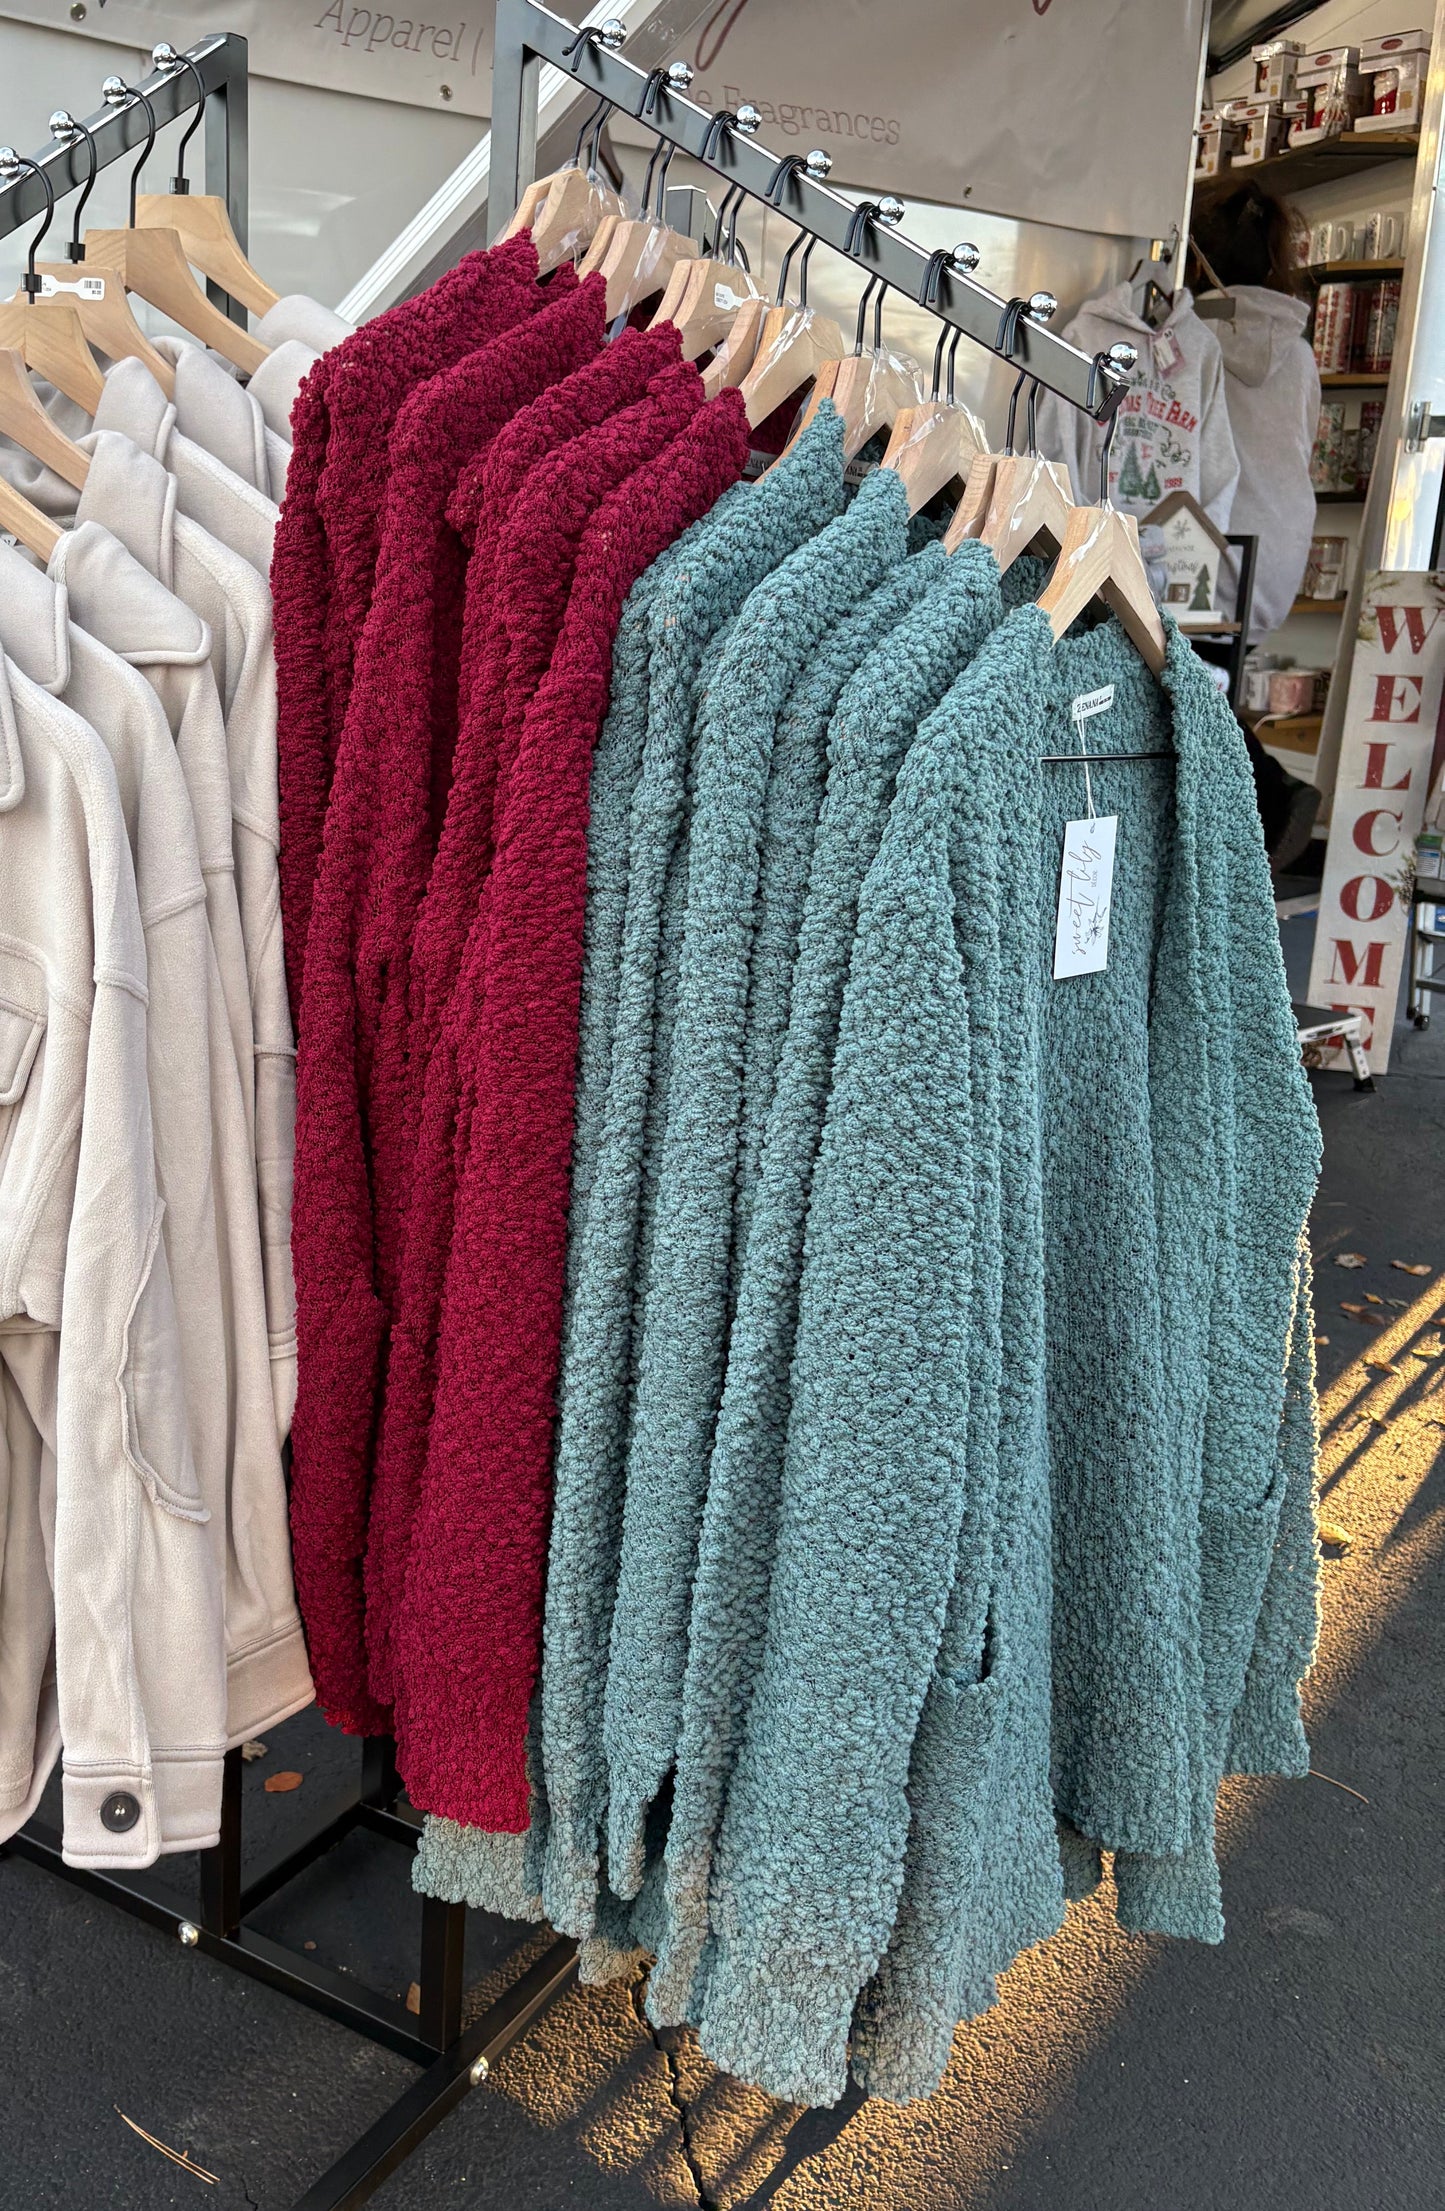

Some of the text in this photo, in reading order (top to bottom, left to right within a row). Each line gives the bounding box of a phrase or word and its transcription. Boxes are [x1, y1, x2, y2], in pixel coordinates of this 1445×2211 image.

[314, 0, 466, 62] Apparel
[1066, 840, 1102, 955] sweet lily
